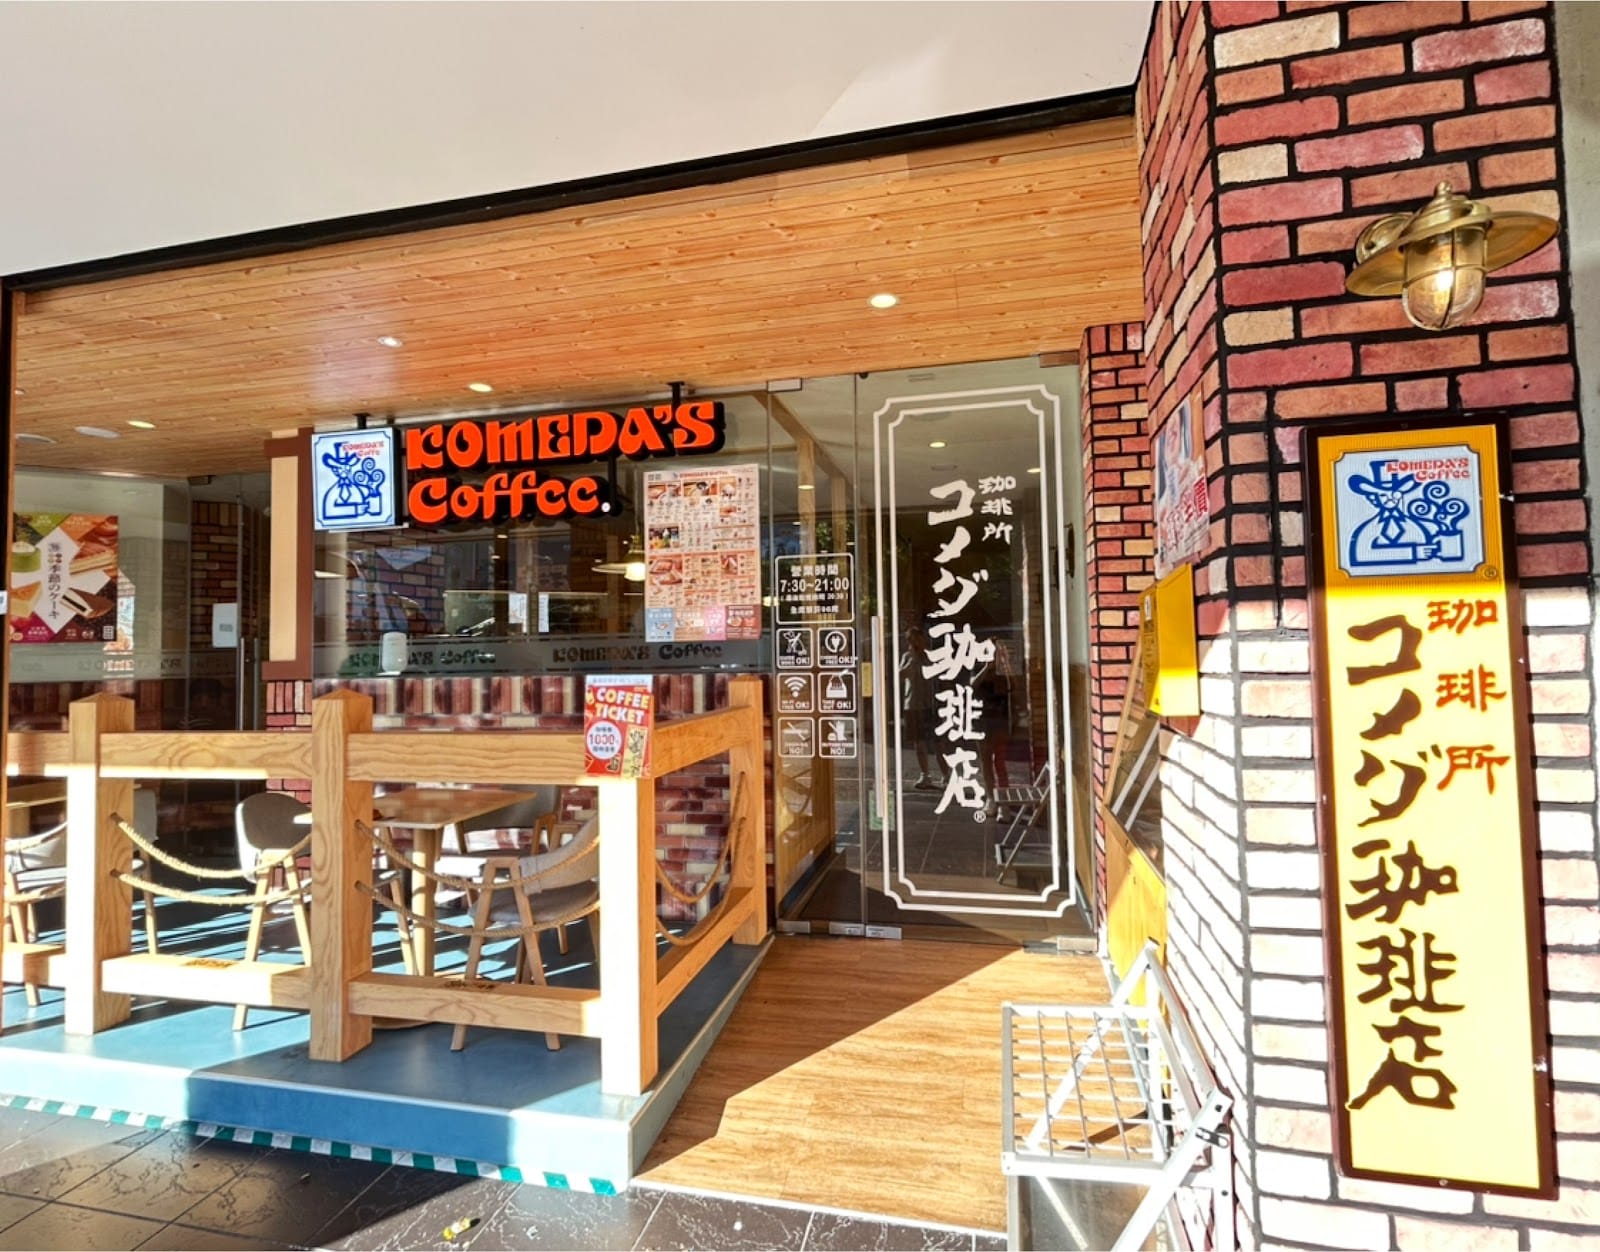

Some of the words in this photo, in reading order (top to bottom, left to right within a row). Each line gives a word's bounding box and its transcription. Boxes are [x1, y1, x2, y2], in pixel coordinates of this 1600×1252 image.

[406, 401, 715, 472] KOMEDA'S
[1387, 458, 1469, 473] KOMEDA'S
[1416, 469, 1470, 480] Coffee
[978, 475, 1016, 544] 珈琲所
[780, 577, 850, 592] 7:30~21:00
[922, 478, 995, 815] コメダ珈琲店
[595, 702, 645, 724] TICKET
[596, 687, 650, 709] COFFEE
[1427, 599, 1509, 793] 珈琲所
[1344, 613, 1466, 1111] コメダ珈琲店
